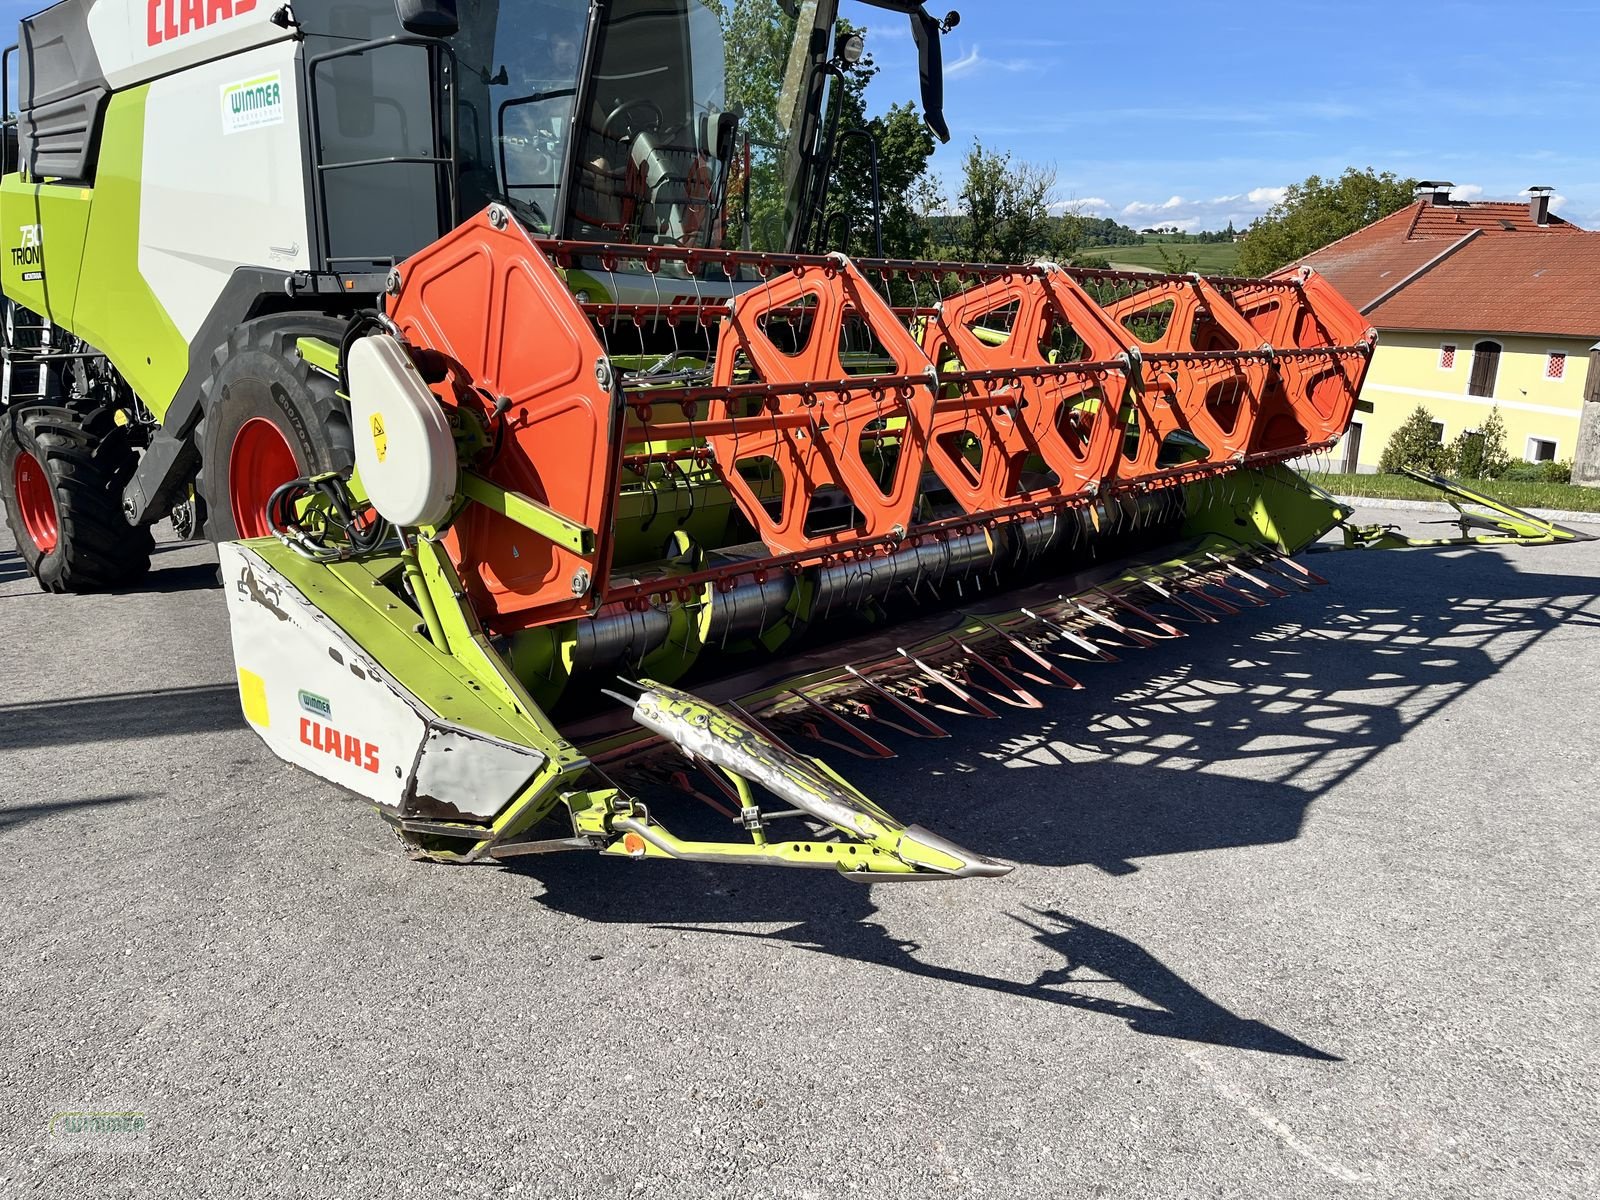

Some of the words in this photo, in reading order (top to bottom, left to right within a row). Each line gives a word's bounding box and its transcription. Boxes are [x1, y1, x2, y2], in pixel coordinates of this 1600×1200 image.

[147, 0, 257, 47] CLA
[231, 82, 281, 114] WIMMER
[19, 224, 44, 248] 730
[11, 246, 40, 266] TRION
[302, 693, 331, 715] WIMMER
[299, 717, 379, 774] CLAAS
